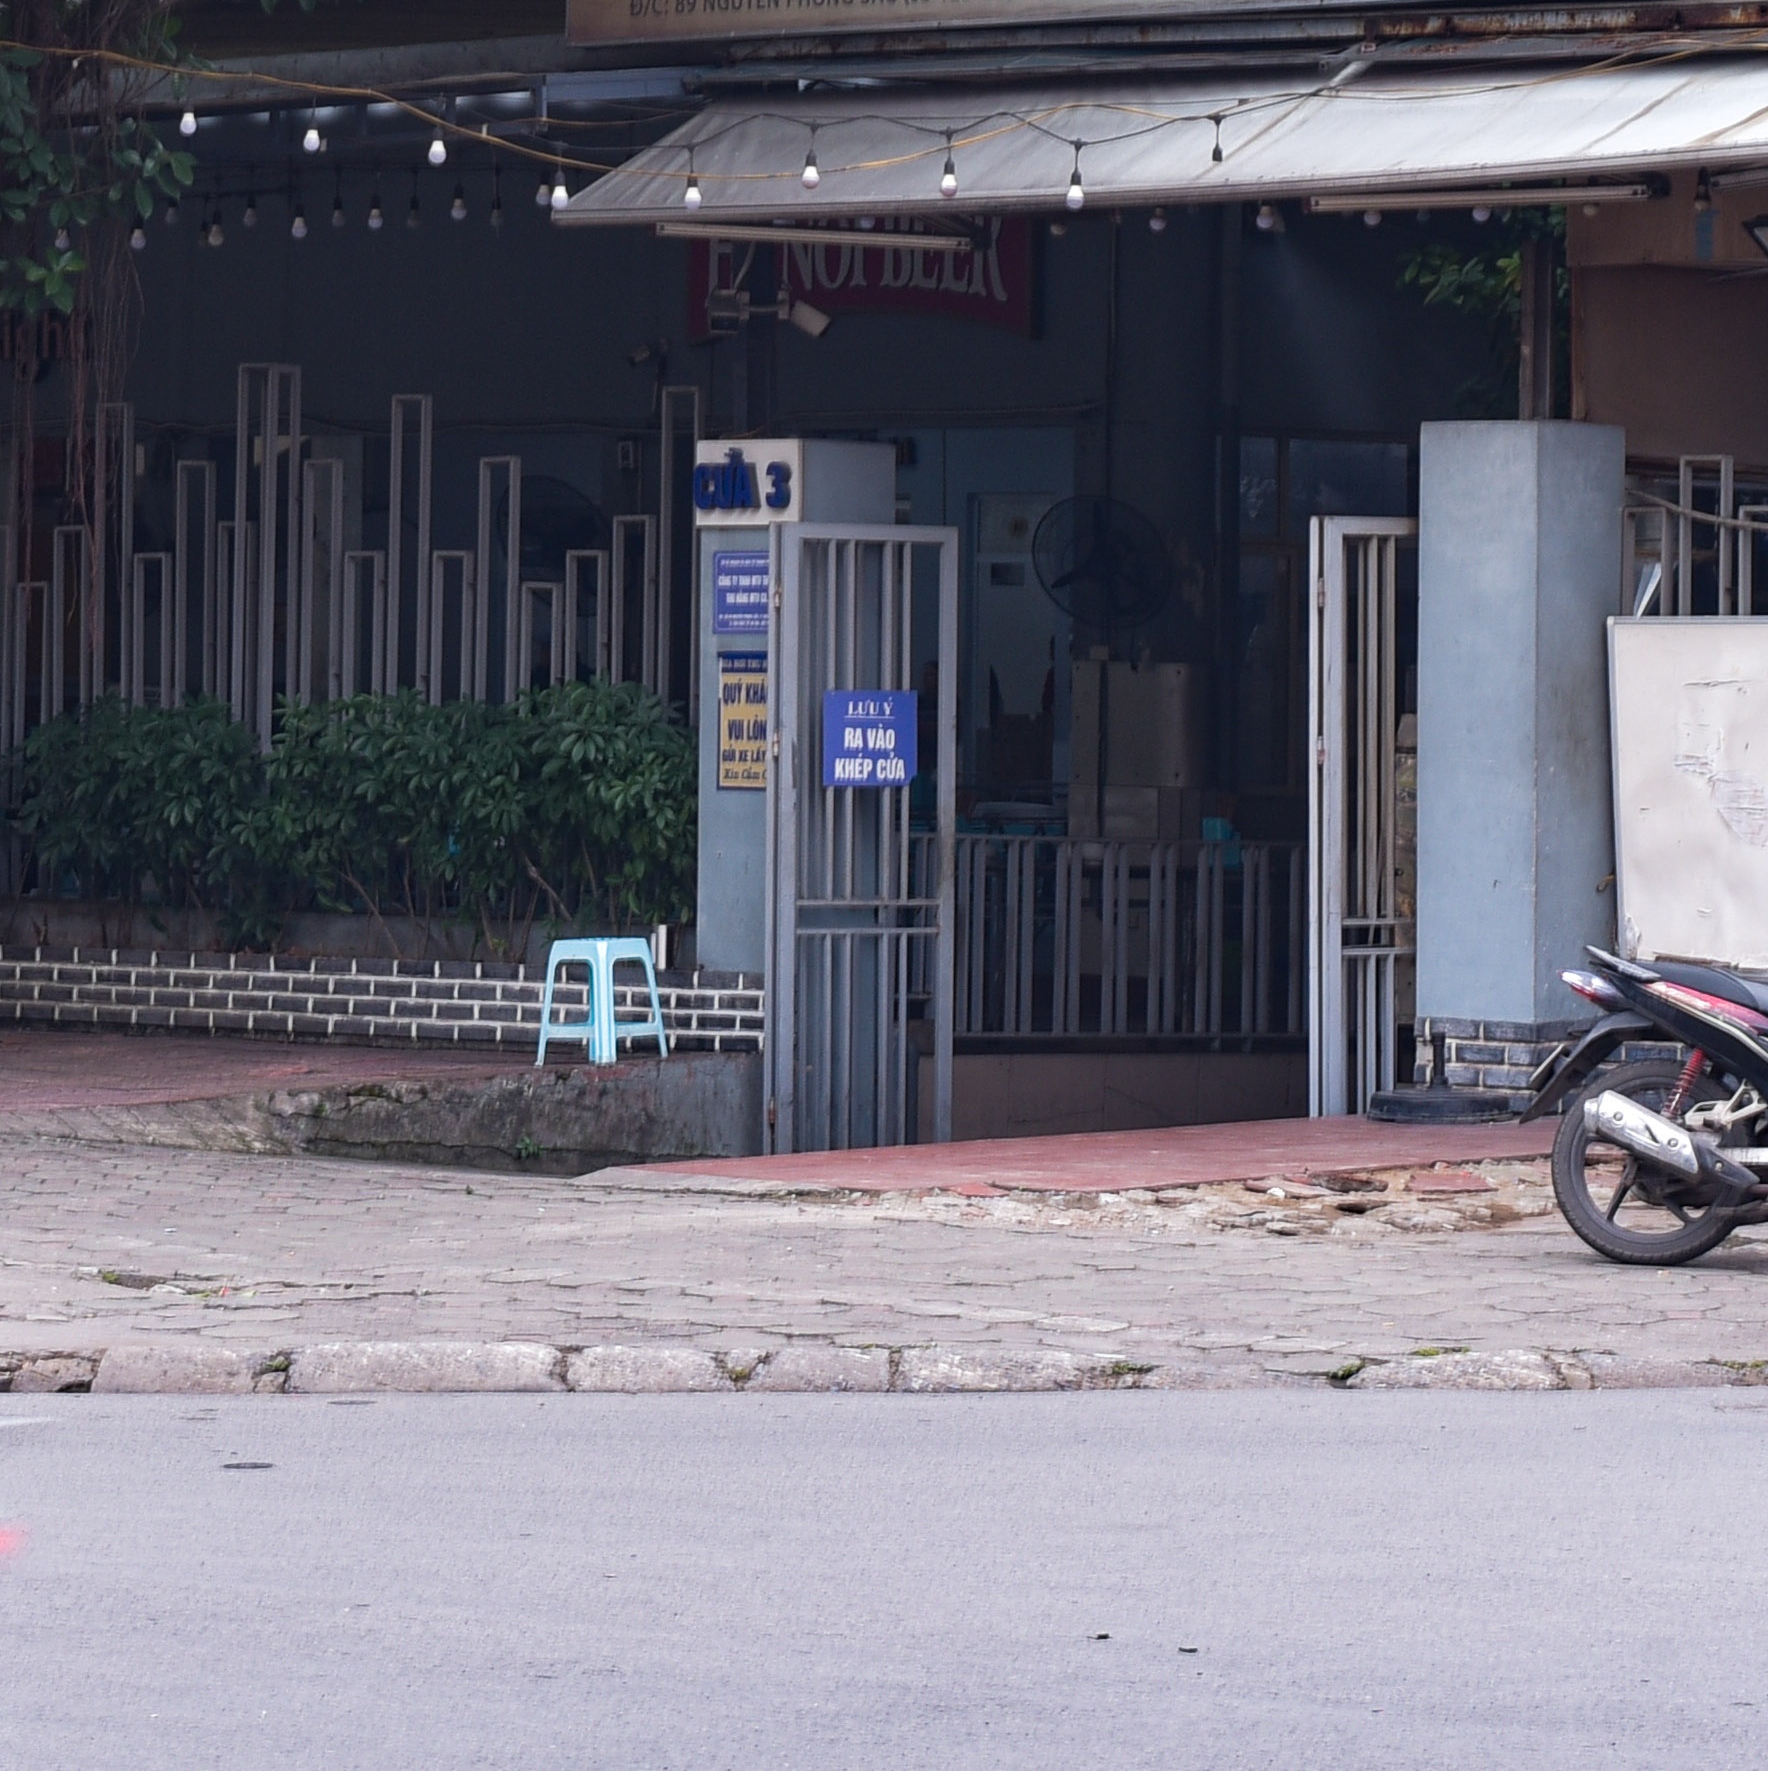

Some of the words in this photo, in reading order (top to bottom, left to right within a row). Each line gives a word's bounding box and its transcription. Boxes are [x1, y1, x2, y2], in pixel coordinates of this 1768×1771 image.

[694, 447, 758, 510] CỬA
[766, 461, 792, 510] 3
[722, 678, 742, 706] QUÝ
[745, 678, 768, 705] KHÁ
[847, 699, 879, 716] LƯU
[882, 697, 894, 716] Ý
[727, 718, 744, 741] VUI
[746, 715, 768, 740] LÒN
[844, 727, 863, 750] RA
[866, 723, 896, 751] VÀO
[738, 749, 749, 762] XE
[834, 752, 873, 781] KHÉP
[876, 749, 906, 780] CỬA
